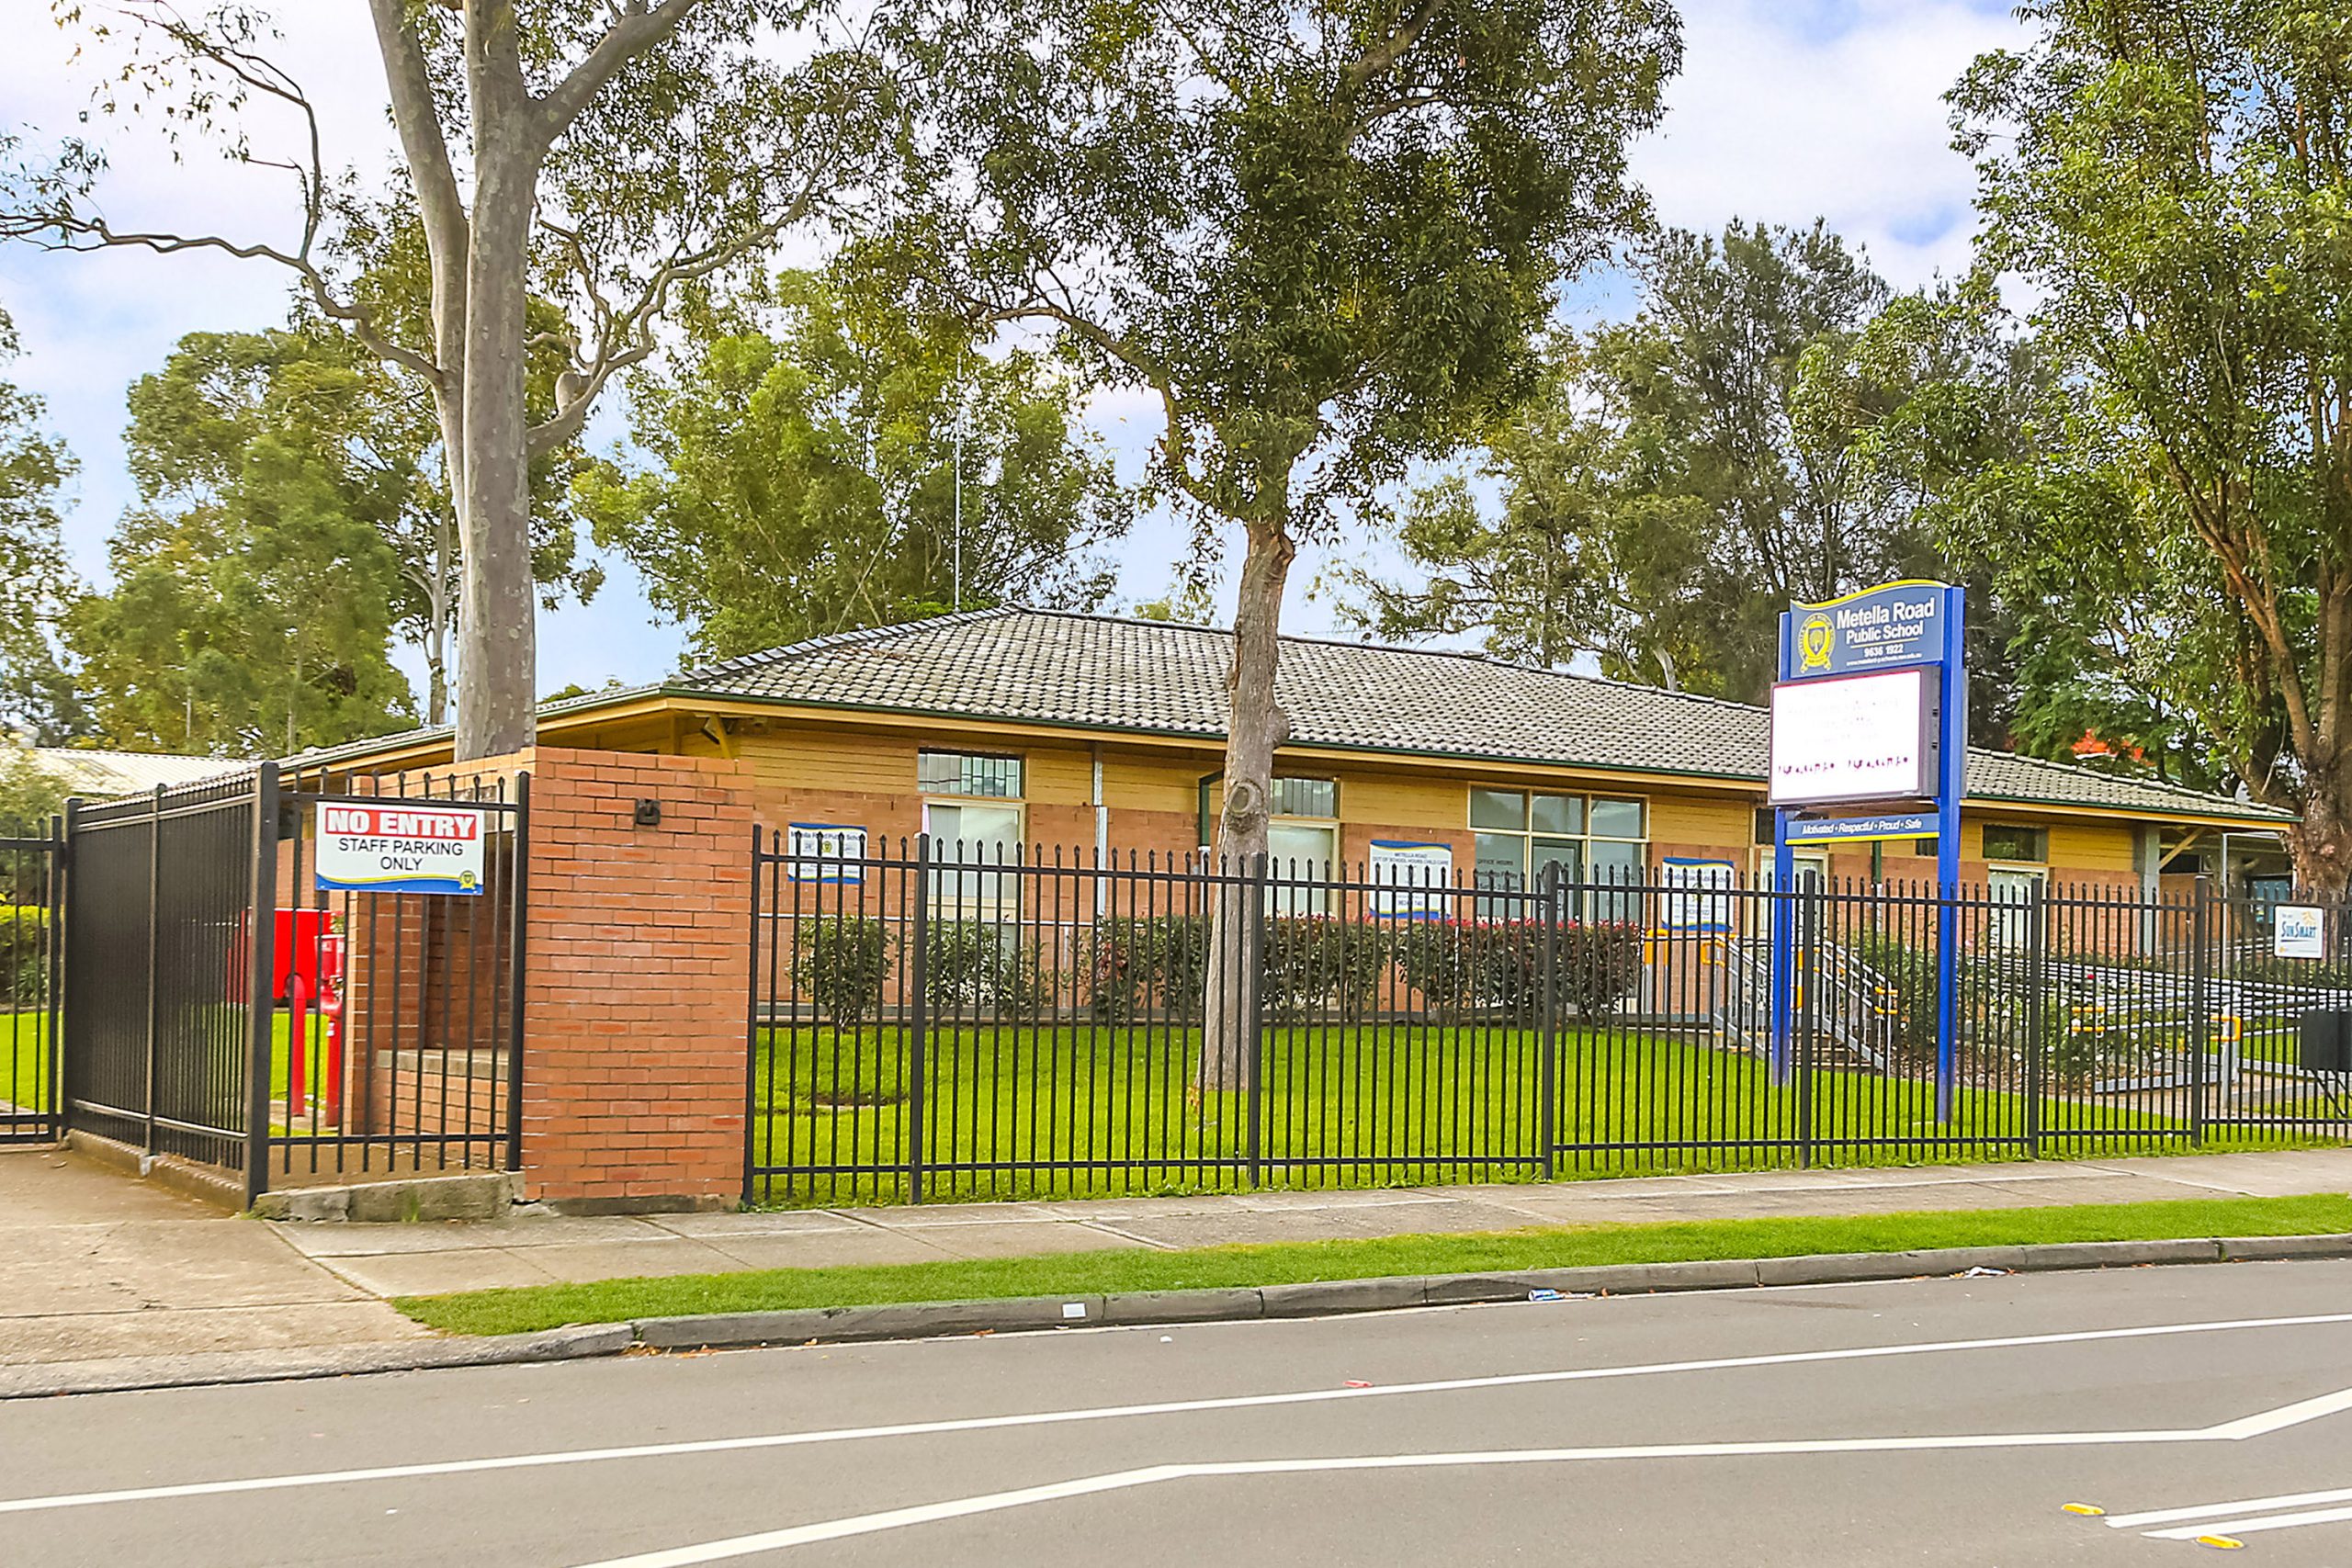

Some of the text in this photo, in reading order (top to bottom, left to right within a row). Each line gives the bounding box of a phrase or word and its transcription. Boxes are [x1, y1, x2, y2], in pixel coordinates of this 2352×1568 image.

[1837, 597, 1935, 630] Metella Road
[1846, 620, 1924, 645] Public School
[327, 809, 475, 839] NO ENTRY
[1802, 824, 1835, 835] Motivated
[1878, 819, 1901, 830] Proud
[1905, 818, 1922, 829] Safe
[338, 838, 464, 856] STAFF PARKING
[379, 857, 424, 871] ONLY
